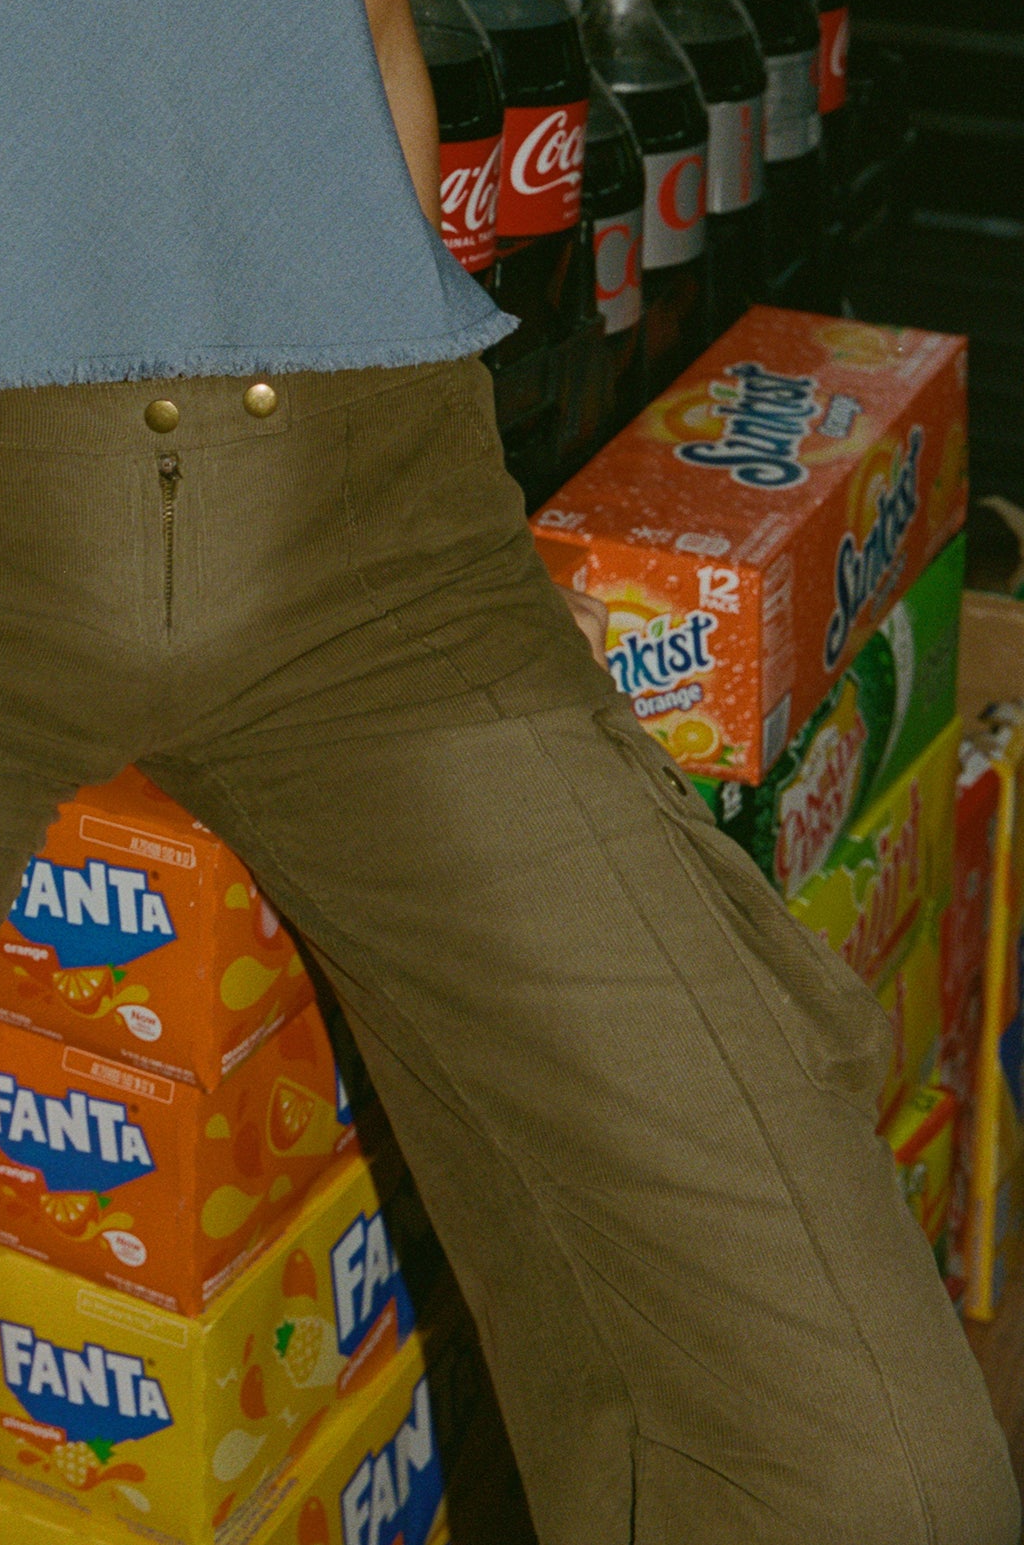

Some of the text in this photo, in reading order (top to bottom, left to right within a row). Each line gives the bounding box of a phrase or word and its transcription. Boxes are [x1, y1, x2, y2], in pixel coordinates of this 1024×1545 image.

[676, 362, 819, 488] Sunkist
[697, 566, 740, 599] 12
[634, 683, 703, 717] Orange
[10, 859, 173, 936] ANTA
[2, 942, 49, 962] orange
[331, 1214, 400, 1343] FA
[0, 1322, 172, 1422] FANTA
